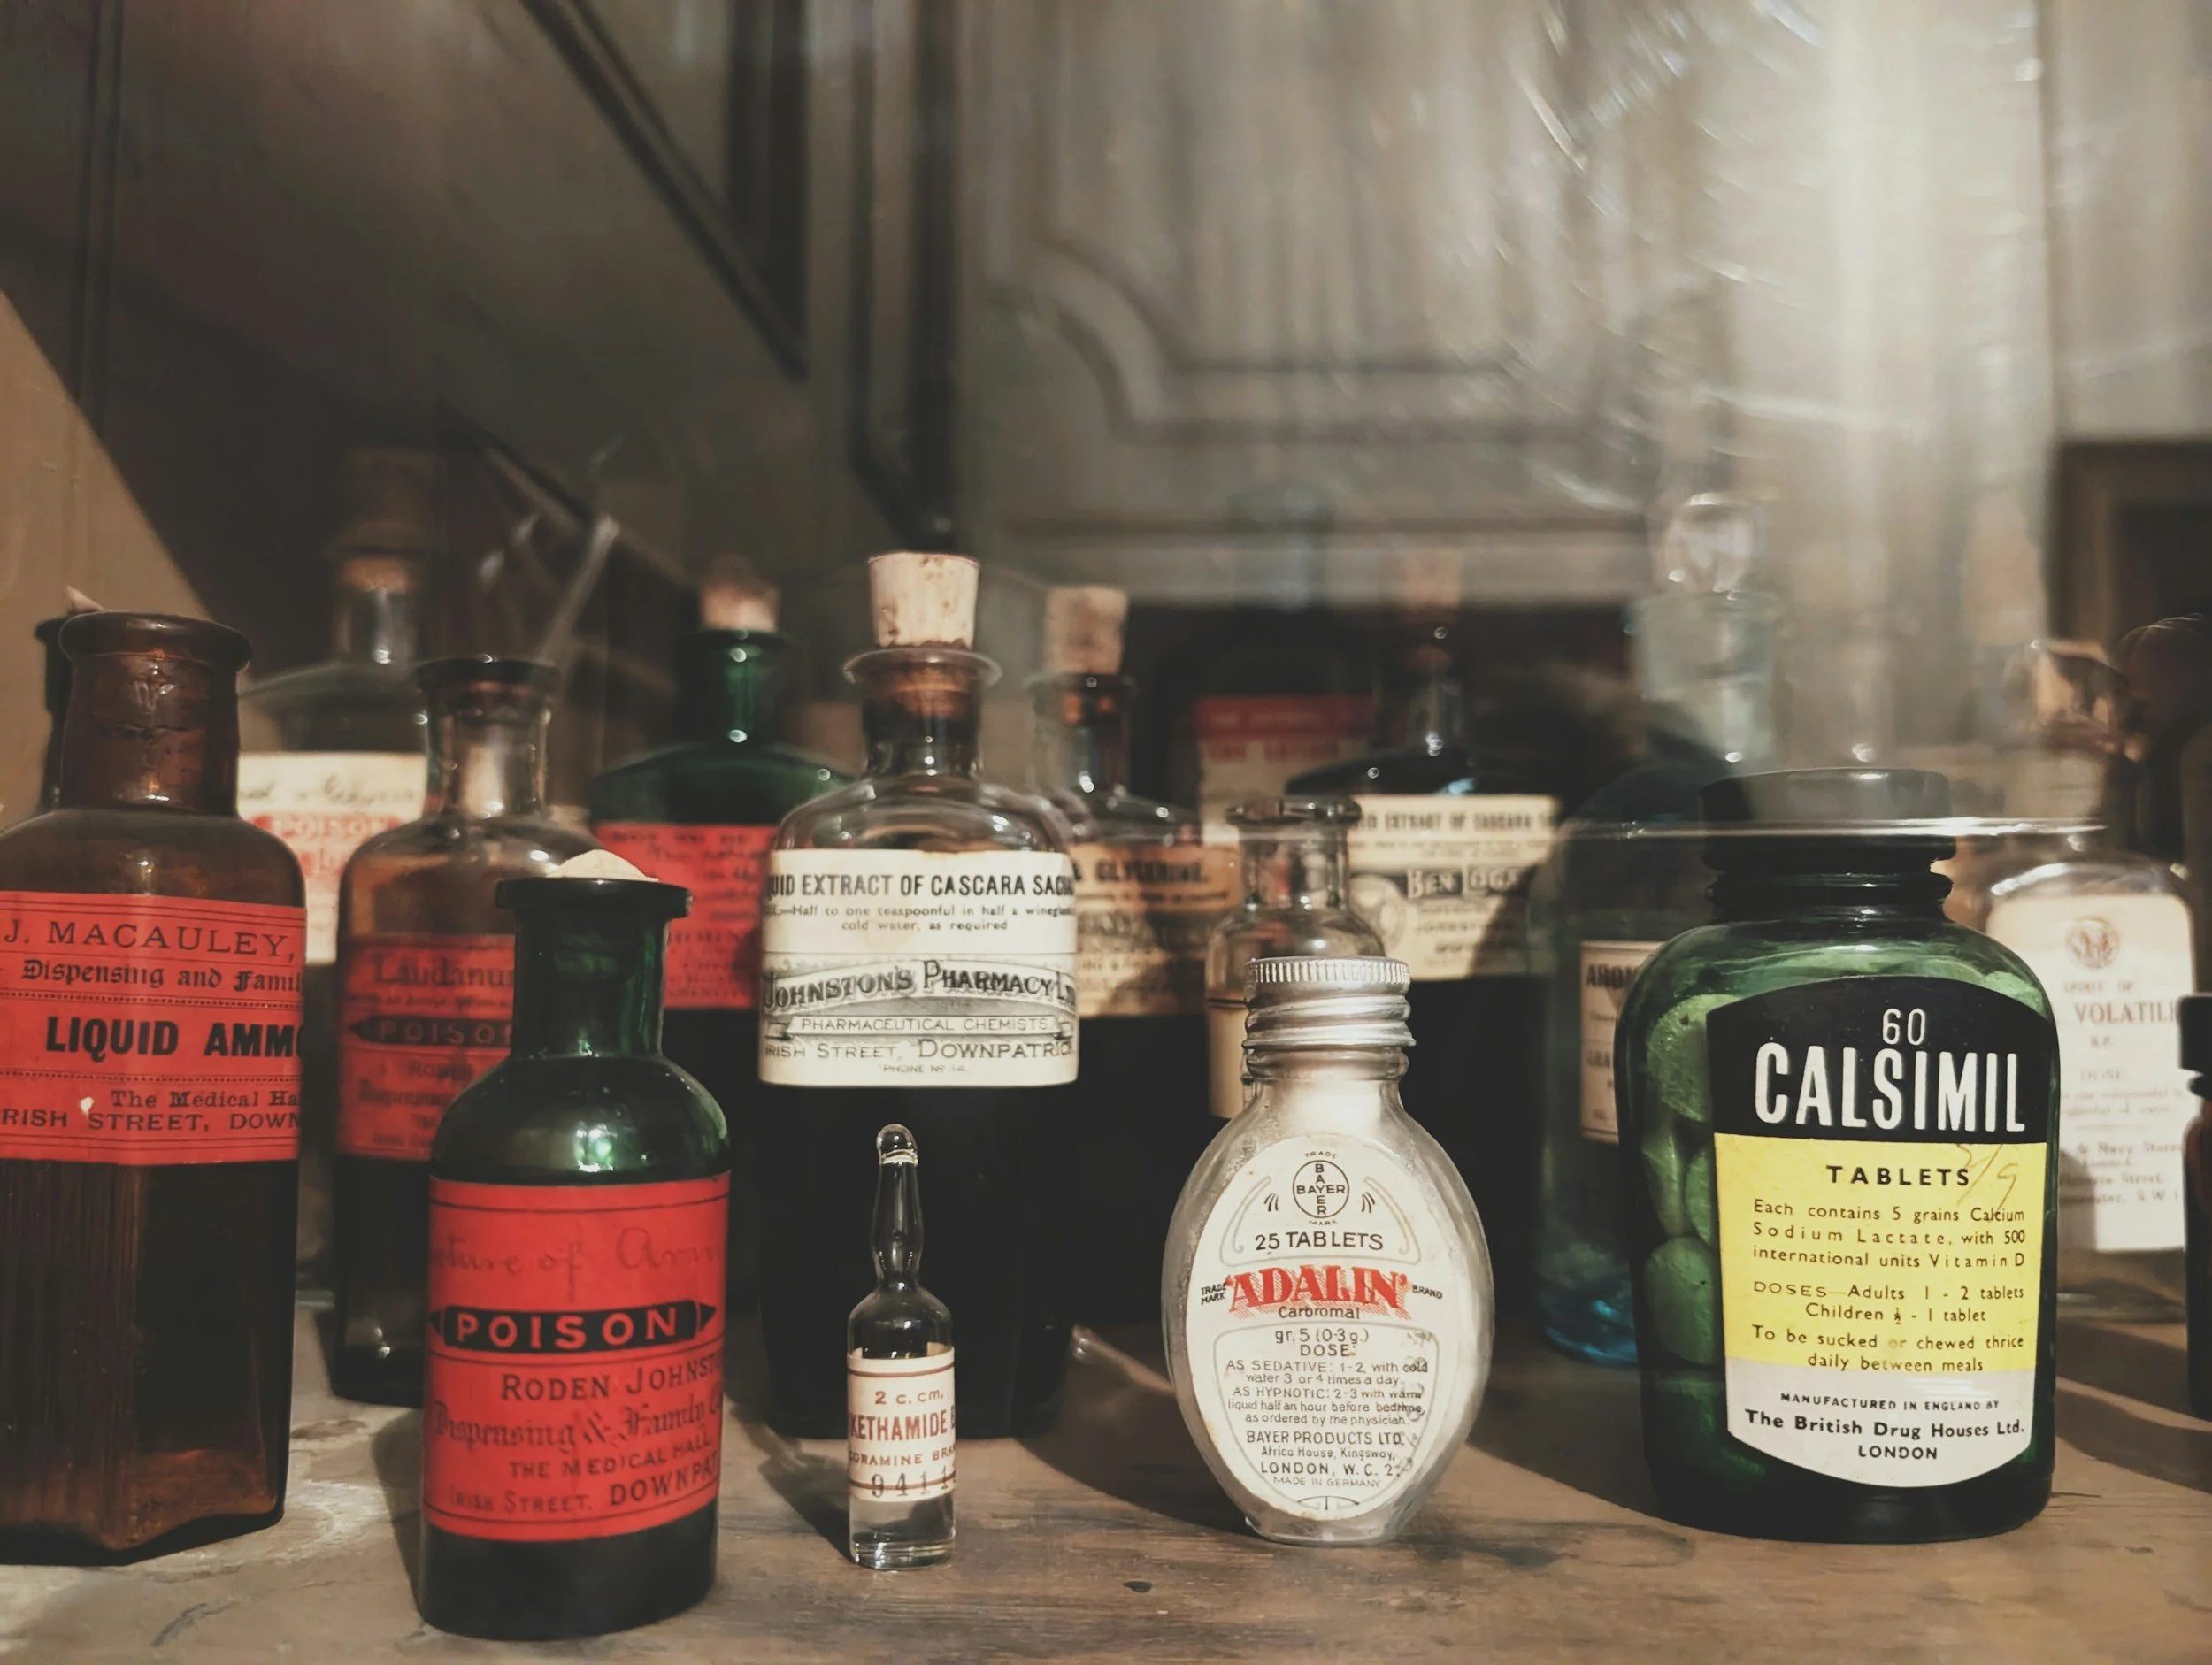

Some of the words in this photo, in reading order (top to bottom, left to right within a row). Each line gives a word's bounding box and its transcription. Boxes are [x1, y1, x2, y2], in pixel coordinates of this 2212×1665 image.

[802, 874, 893, 896] EXTRACT
[900, 874, 925, 896] OF
[931, 874, 1025, 896] CASCARA
[825, 905, 839, 916] to
[846, 908, 871, 917] one
[878, 904, 955, 918] teaspoonful
[981, 904, 1005, 916] half
[841, 920, 869, 931] cold
[929, 922, 941, 931] as
[4, 919, 30, 944] J.
[48, 920, 296, 963] MACAULEY,
[21, 958, 165, 989] Dispensing
[177, 968, 222, 987] and
[923, 958, 1053, 997] PHARMACY
[802, 1018, 955, 1031] PHARMACEUTICAL
[1882, 1007, 1926, 1047] 60
[47, 1017, 180, 1063] LIQUID
[1755, 1041, 2025, 1133] CALSIMIL
[111, 1090, 157, 1107] The
[169, 1091, 260, 1108] Medical
[88, 1112, 211, 1133] STREET,
[1825, 1164, 1970, 1187] TABLETS
[1296, 1184, 1346, 1194] BAYER
[1754, 1198, 1793, 1216] Each
[1808, 1204, 1881, 1221] contains
[1892, 1206, 1901, 1221] 5
[1913, 1208, 1960, 1224] grains
[1970, 1206, 2025, 1222] Calcium
[1255, 1232, 1280, 1251] 25
[1285, 1230, 1384, 1251] TABLETS
[1753, 1221, 1843, 1242] Sodium
[1962, 1230, 1993, 1245] with
[2004, 1229, 2025, 1245] 500
[1753, 1245, 1870, 1266] international
[1879, 1253, 1920, 1268] units
[1929, 1253, 2008, 1268] Vitamin
[2015, 1253, 2025, 1267] D
[1201, 1282, 1228, 1297] TRADE
[1201, 1291, 1225, 1306] MARK
[1412, 1284, 1444, 1301] BRAND
[1960, 1285, 1970, 1300] 2
[1980, 1285, 2024, 1300] tablets
[1279, 1306, 1360, 1320] Carbromal
[1806, 1302, 1884, 1321] Children
[1944, 1308, 1987, 1322] tablet
[457, 1306, 677, 1350] POISON
[1275, 1330, 1296, 1344] gr.
[1299, 1328, 1310, 1343] 5
[1752, 1324, 1776, 1340] To
[1786, 1328, 1808, 1344] be
[1816, 1331, 1878, 1348] sucked
[1887, 1339, 1908, 1350] or
[1916, 1335, 1975, 1350] chewed
[1985, 1334, 2024, 1349] thrice
[1300, 1344, 1357, 1357] DOSE:
[1226, 1359, 1246, 1371] AS
[1372, 1361, 1399, 1372] with
[1402, 1361, 1428, 1373] cold
[1808, 1353, 1849, 1372] daily
[1861, 1354, 1932, 1372] between
[1942, 1357, 1984, 1372] meals
[502, 1374, 611, 1402] RODEN
[1246, 1373, 1281, 1384] water
[1283, 1373, 1293, 1385] 3
[1298, 1375, 1313, 1385] or
[1315, 1373, 1325, 1383] 4
[1327, 1374, 1362, 1385] times
[1364, 1376, 1372, 1385] a
[874, 1390, 887, 1405] 2
[1233, 1386, 1250, 1397] AS
[1361, 1389, 1385, 1399] with
[1389, 1389, 1423, 1400] warm
[1780, 1392, 1897, 1410] MANUFACTURED
[1903, 1401, 1917, 1411] IN
[1924, 1401, 1981, 1411] ENGLAND
[1986, 1400, 2000, 1410] BY
[1228, 1399, 1257, 1412] liquid
[1260, 1399, 1281, 1411] half
[1283, 1402, 1297, 1411] an
[1300, 1401, 1327, 1412] hour
[1332, 1401, 1371, 1412] before
[1262, 1414, 1308, 1424] ordered
[1312, 1414, 1326, 1427] by
[1330, 1414, 1348, 1425] the
[1745, 1408, 1785, 1429] The
[1794, 1415, 1863, 1434] British
[1873, 1421, 1922, 1440] Drug
[1931, 1423, 1989, 1438] Houses
[1997, 1419, 2025, 1436] Ltd.
[1247, 1430, 1289, 1444] BAYER
[1294, 1431, 1373, 1445] PRODUCTS
[1262, 1446, 1294, 1457] Africa
[1857, 1444, 1939, 1460] LONDON
[509, 1461, 551, 1479] THE
[562, 1446, 668, 1477] MEDICAL
[1273, 1476, 1307, 1486] MADE
[1311, 1477, 1323, 1486] IN
[1326, 1477, 1382, 1488] GERMANY
